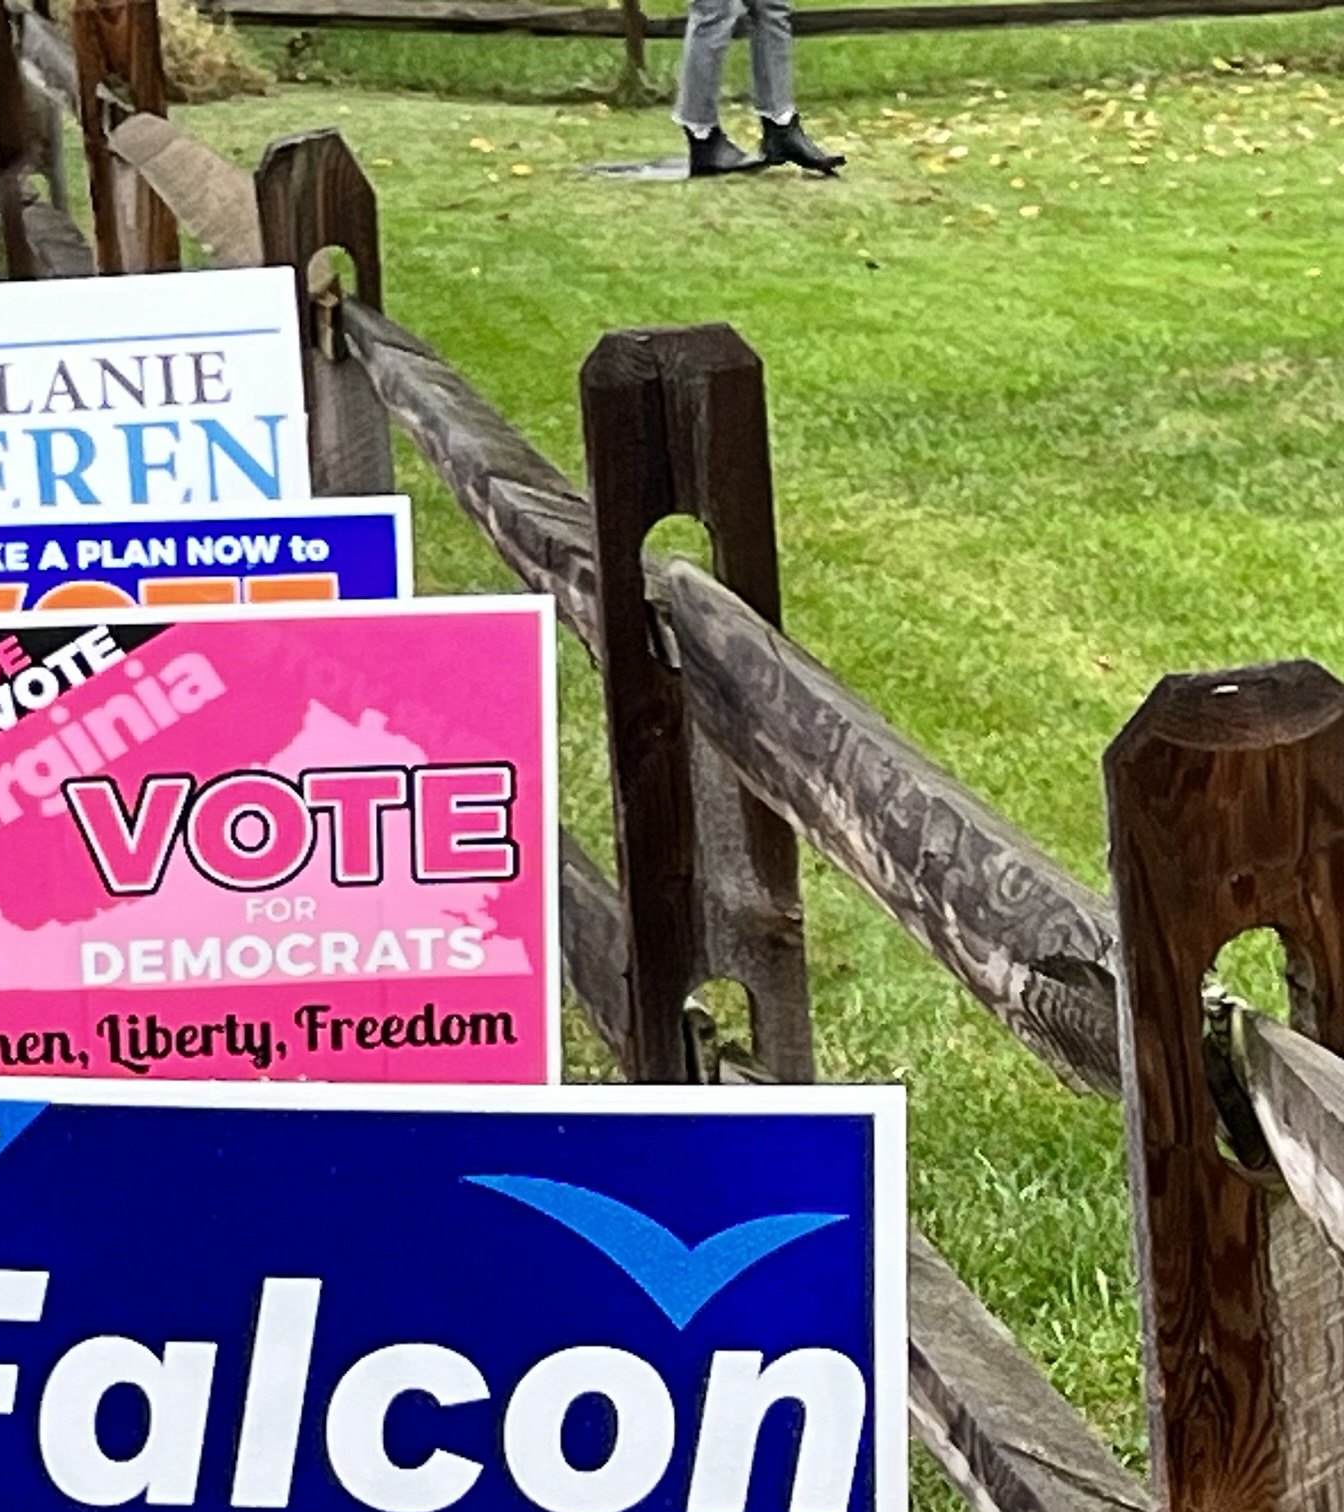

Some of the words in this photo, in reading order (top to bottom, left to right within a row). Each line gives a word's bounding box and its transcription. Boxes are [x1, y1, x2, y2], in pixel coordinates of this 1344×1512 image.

[38, 541, 69, 571] A
[77, 538, 179, 570] PLAN
[187, 535, 281, 567] NOW
[289, 537, 330, 563] to
[62, 762, 519, 896] VOTE
[245, 896, 319, 923] FOR
[81, 926, 486, 986] DEMOCRATS
[95, 1012, 288, 1074] Liberty,
[293, 1003, 519, 1054] Freedom
